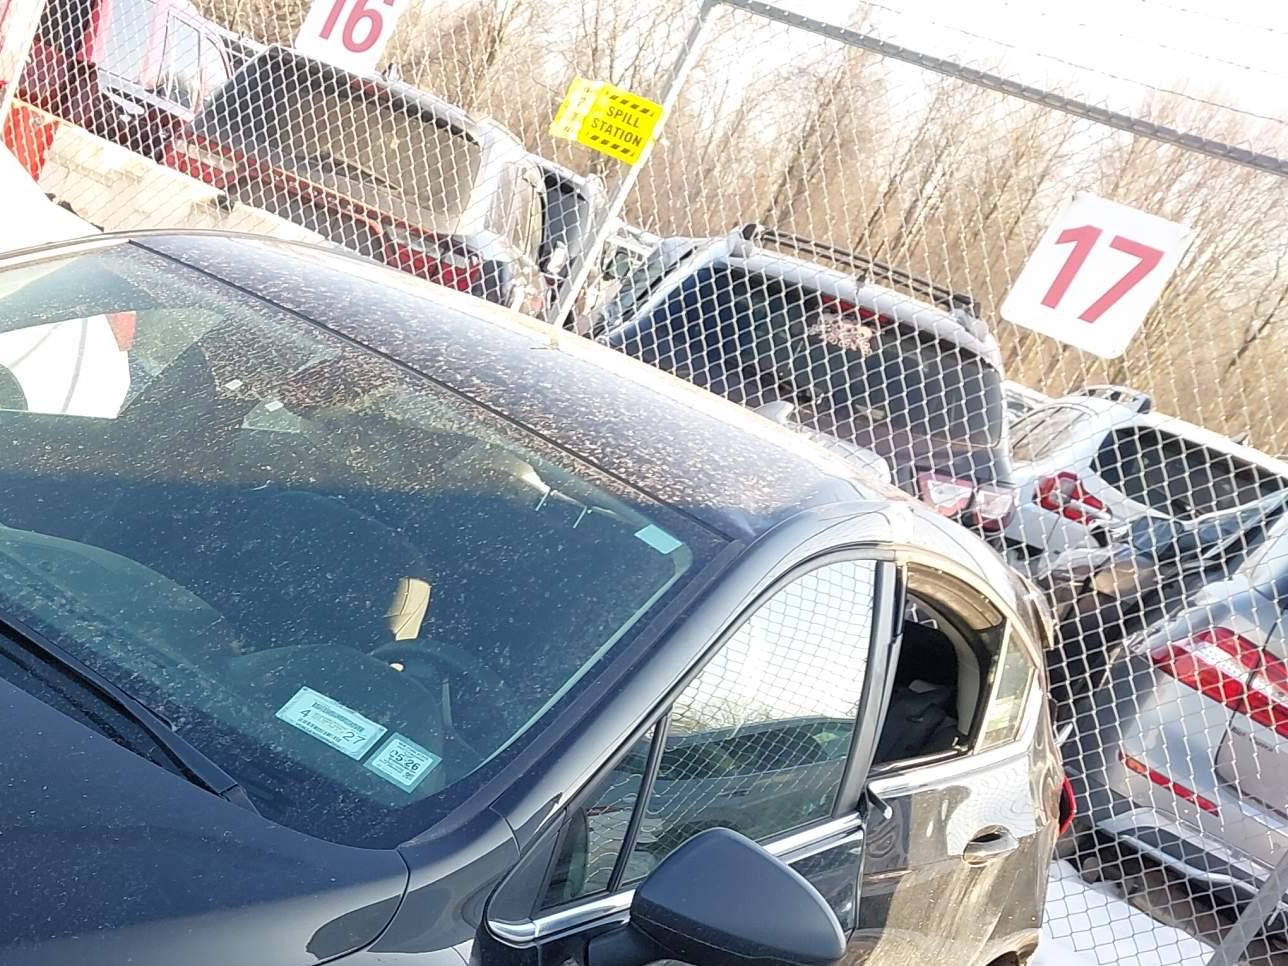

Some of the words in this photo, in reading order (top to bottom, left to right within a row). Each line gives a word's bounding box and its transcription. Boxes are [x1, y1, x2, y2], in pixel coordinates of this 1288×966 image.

[318, 0, 383, 53] 16
[591, 117, 643, 148] STATION
[606, 106, 641, 129] SPILL
[1040, 224, 1166, 324] 17
[342, 731, 367, 745] 27
